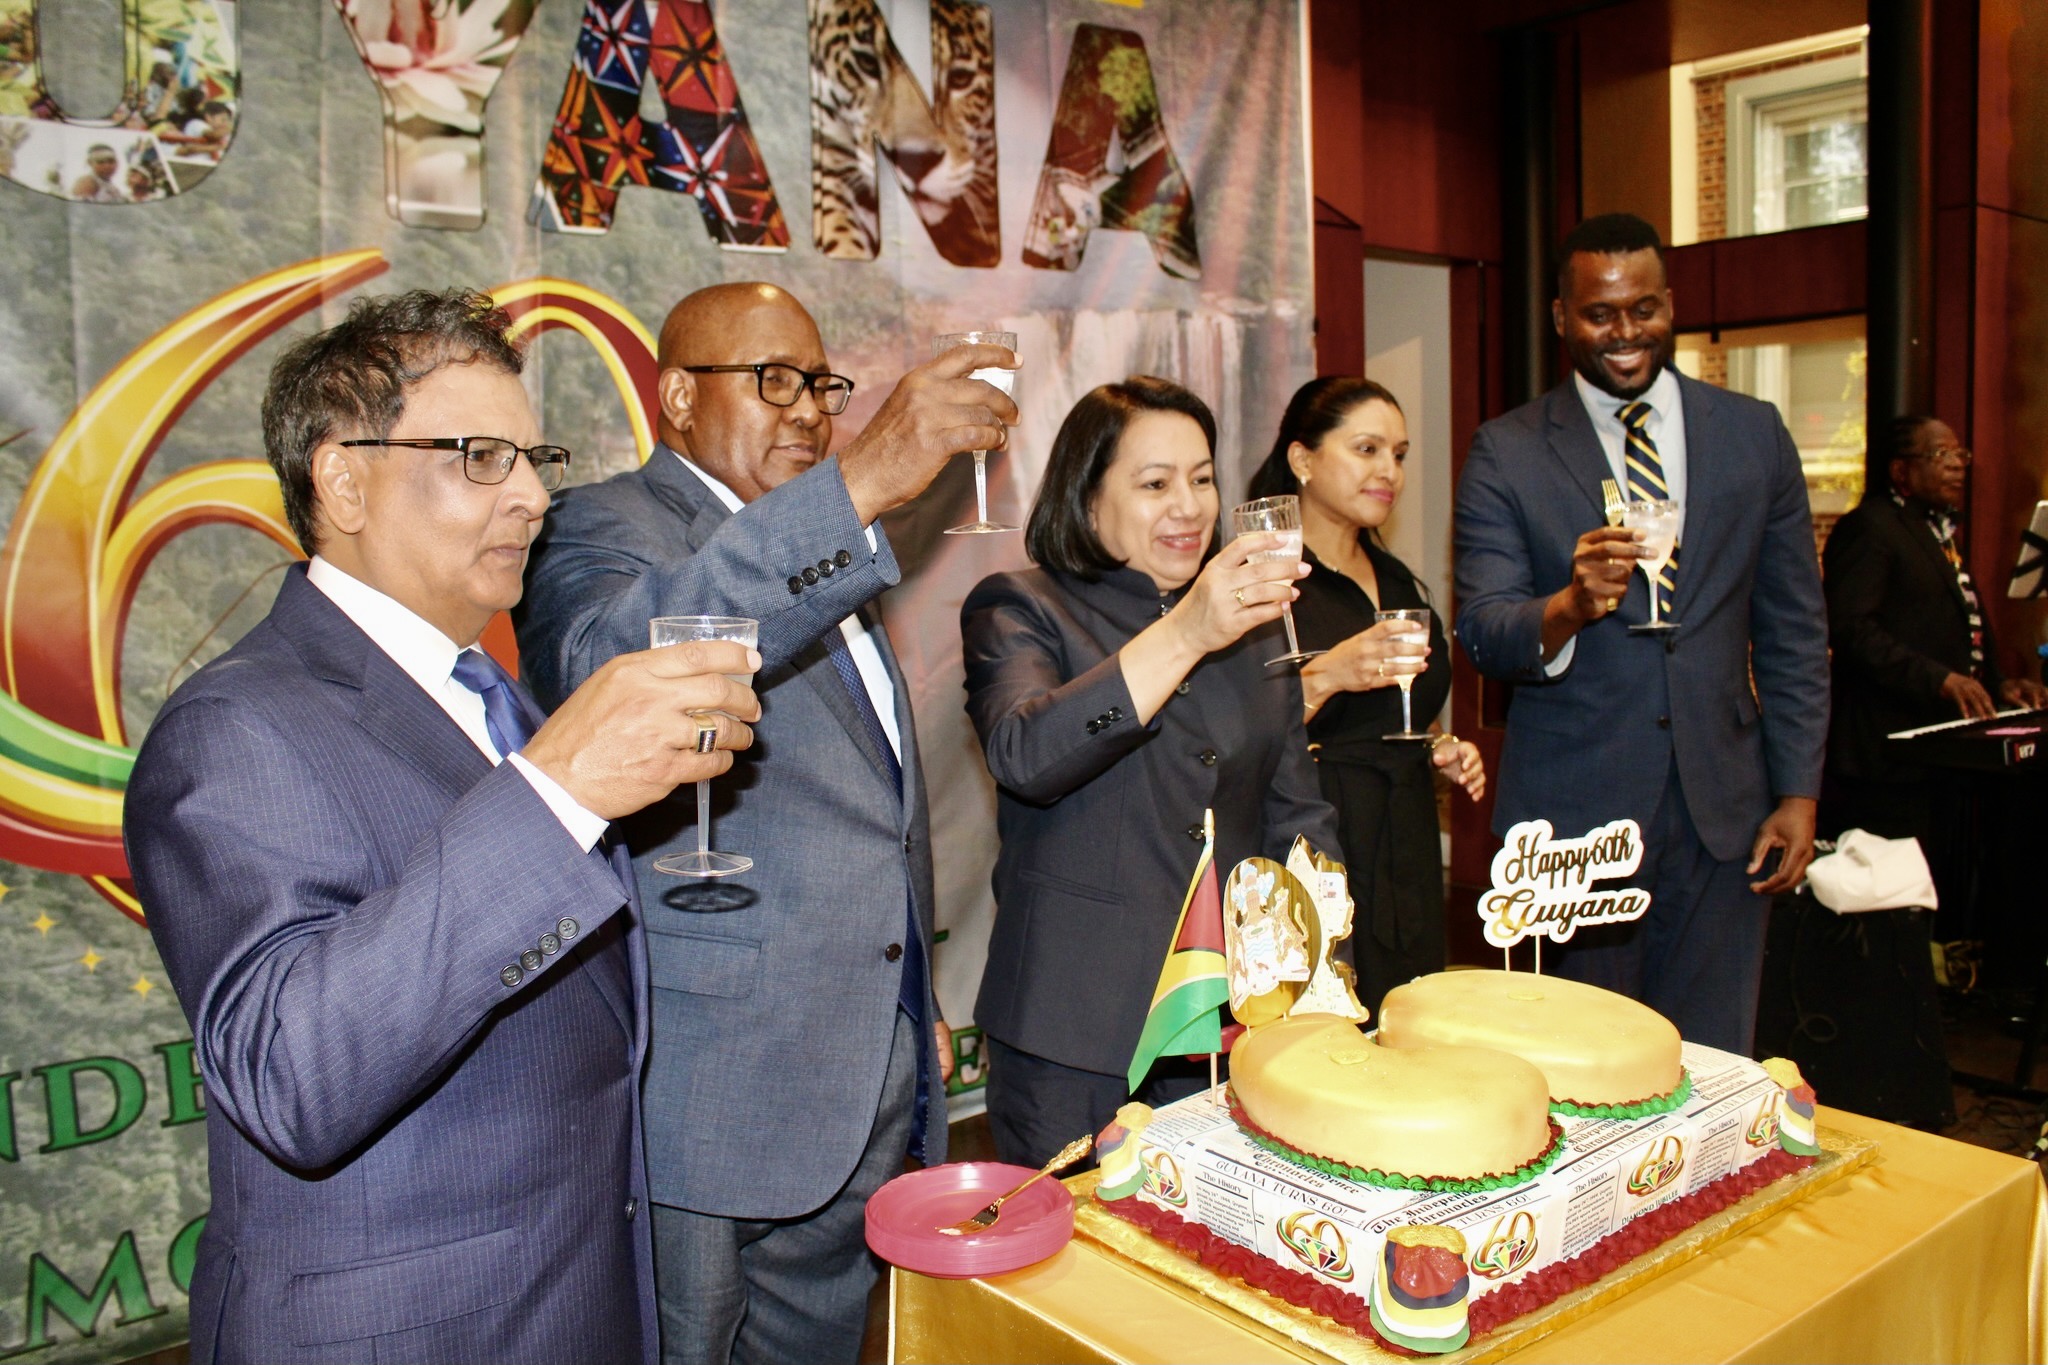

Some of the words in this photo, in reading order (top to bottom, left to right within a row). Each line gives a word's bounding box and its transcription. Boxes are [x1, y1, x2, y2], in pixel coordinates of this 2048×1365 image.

[1505, 832, 1591, 889] Happy
[1591, 827, 1635, 866] 60th
[1487, 889, 1645, 939] Guyana
[1203, 1171, 1216, 1185] The
[1217, 1176, 1242, 1194] History
[1575, 1182, 1587, 1193] The
[1587, 1171, 1608, 1187] History
[1273, 1182, 1318, 1206] TURNS
[1373, 1215, 1404, 1234] The
[1457, 1203, 1505, 1226] TURNS
